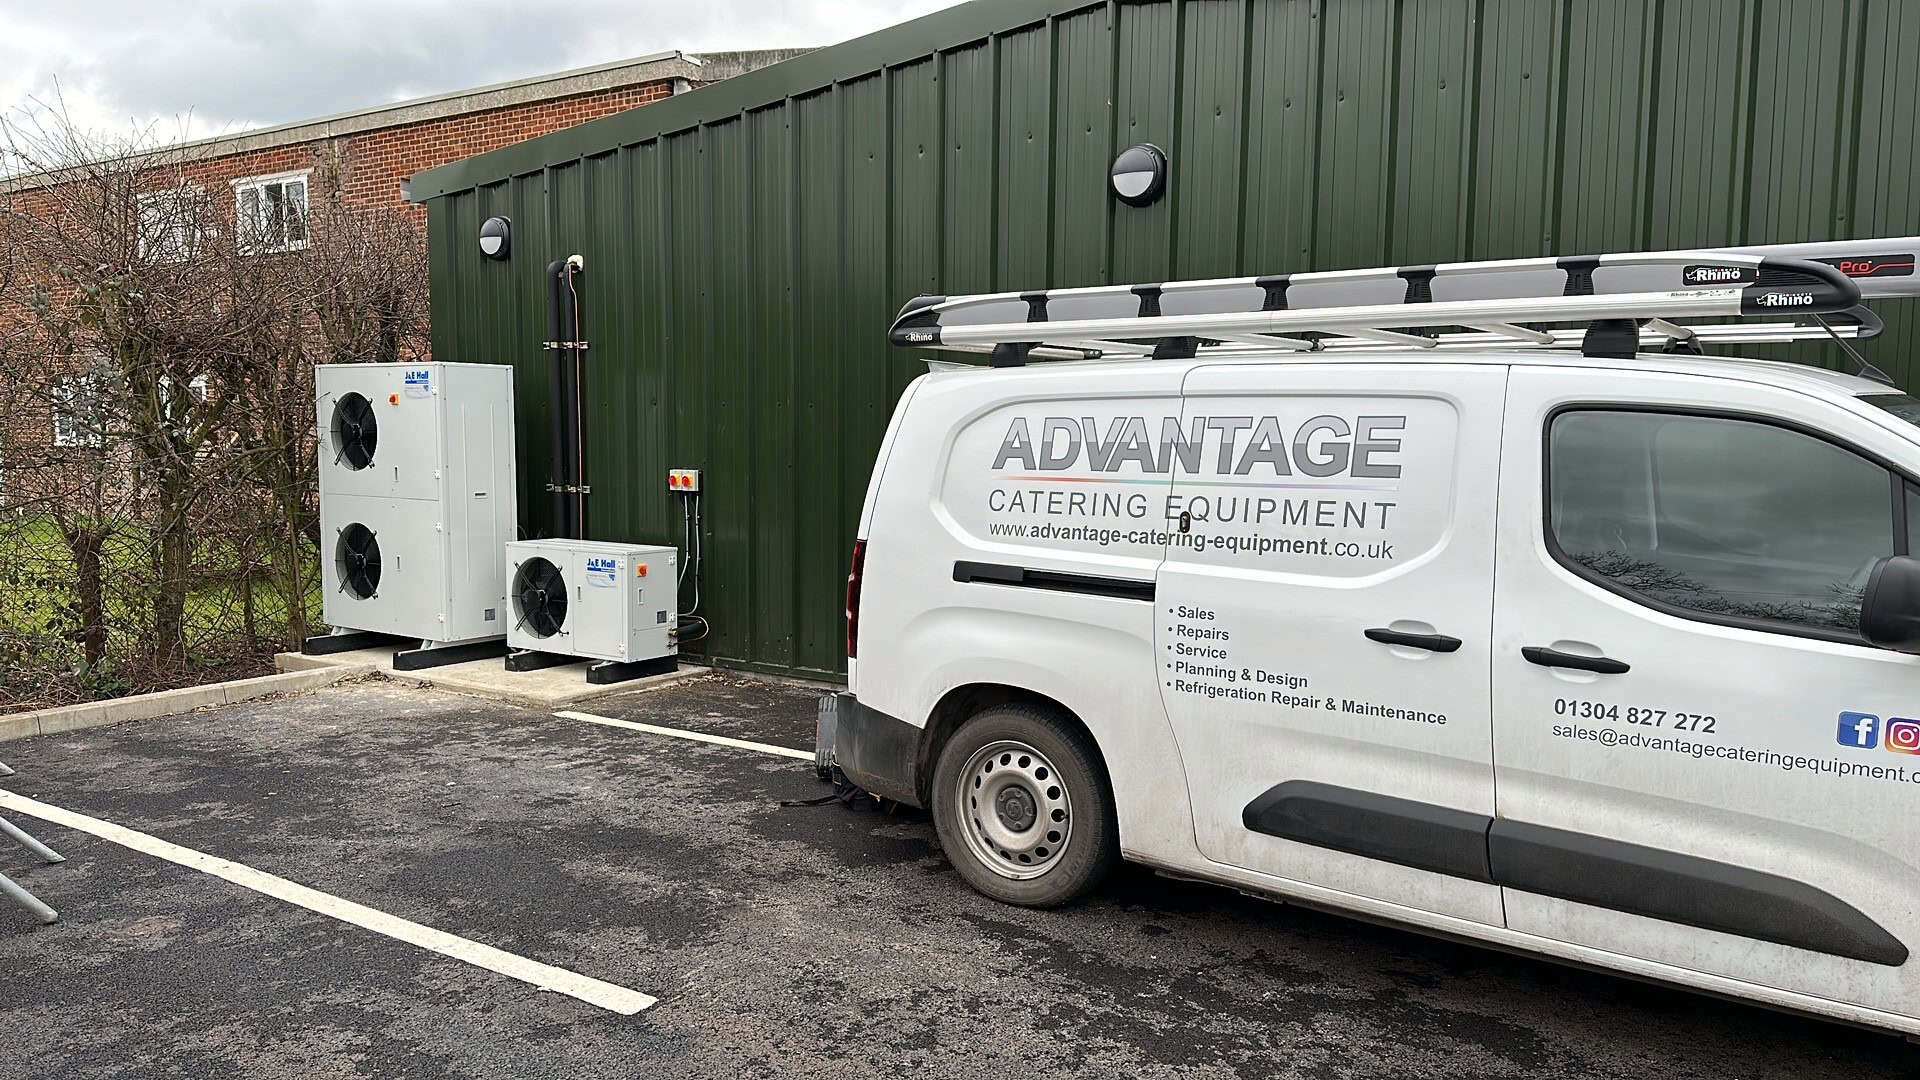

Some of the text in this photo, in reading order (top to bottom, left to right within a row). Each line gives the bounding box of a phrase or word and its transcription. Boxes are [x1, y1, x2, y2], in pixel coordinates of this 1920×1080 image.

[1696, 268, 1741, 281] Rhino
[1840, 262, 1870, 272] Pro
[1766, 294, 1813, 306] Rhino
[910, 333, 933, 341] Rhino
[416, 370, 429, 380] Hall
[992, 415, 1407, 478] ADVANTAGE
[989, 489, 1397, 529] CATERING EQUIPMENT
[989, 522, 1394, 560] www.advantage-catering-equipment.co.uk
[587, 558, 616, 569] J&E Hall
[1177, 606, 1215, 621] Sales
[1176, 625, 1230, 642] Repairs
[1175, 643, 1228, 660] Service
[1175, 661, 1309, 688] Planning & Design
[1175, 679, 1448, 725] Refrigeration Repair & Maintenance
[1554, 698, 1717, 734] 01304 827 272
